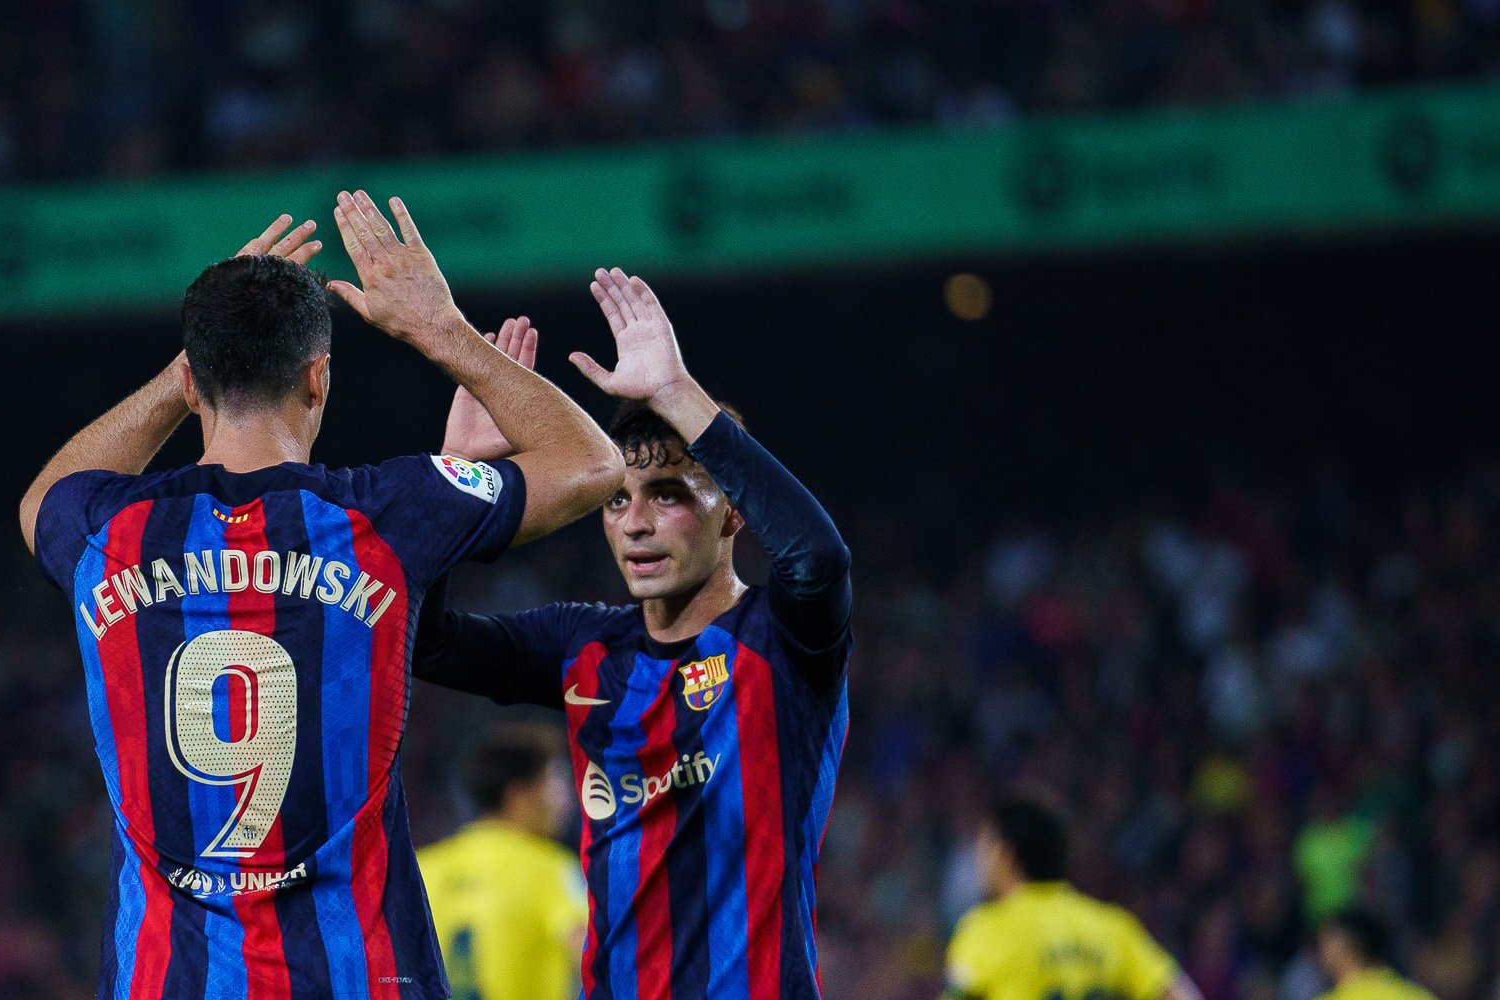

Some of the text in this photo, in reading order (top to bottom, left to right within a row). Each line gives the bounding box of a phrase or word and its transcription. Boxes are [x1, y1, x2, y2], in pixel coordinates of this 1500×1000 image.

[79, 549, 397, 641] LEWANDOWSKI
[164, 630, 298, 859] 9
[620, 751, 721, 807] Spotify
